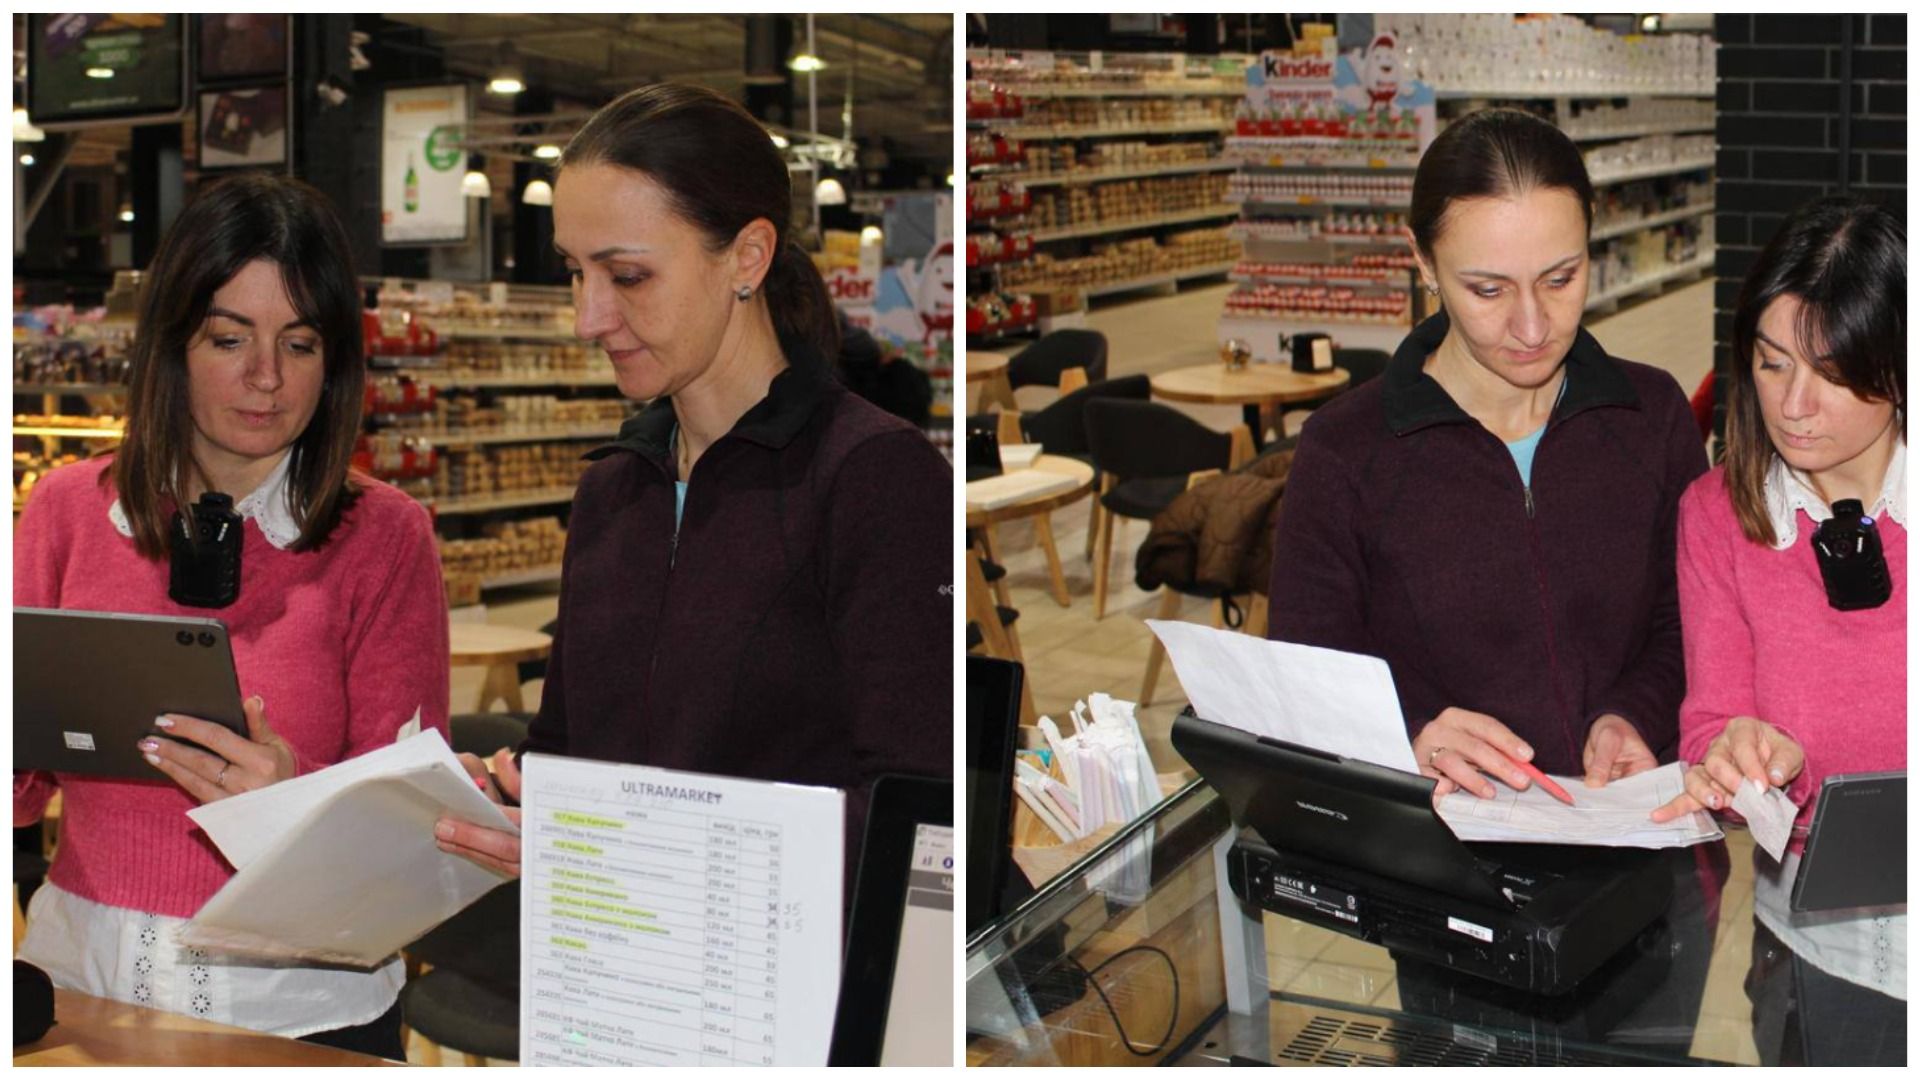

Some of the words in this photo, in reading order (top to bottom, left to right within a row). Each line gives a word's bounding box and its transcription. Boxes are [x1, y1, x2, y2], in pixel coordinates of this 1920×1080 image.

[1265, 57, 1332, 77] Kinder
[830, 274, 872, 298] der
[621, 780, 723, 806] ULTRAMARKET
